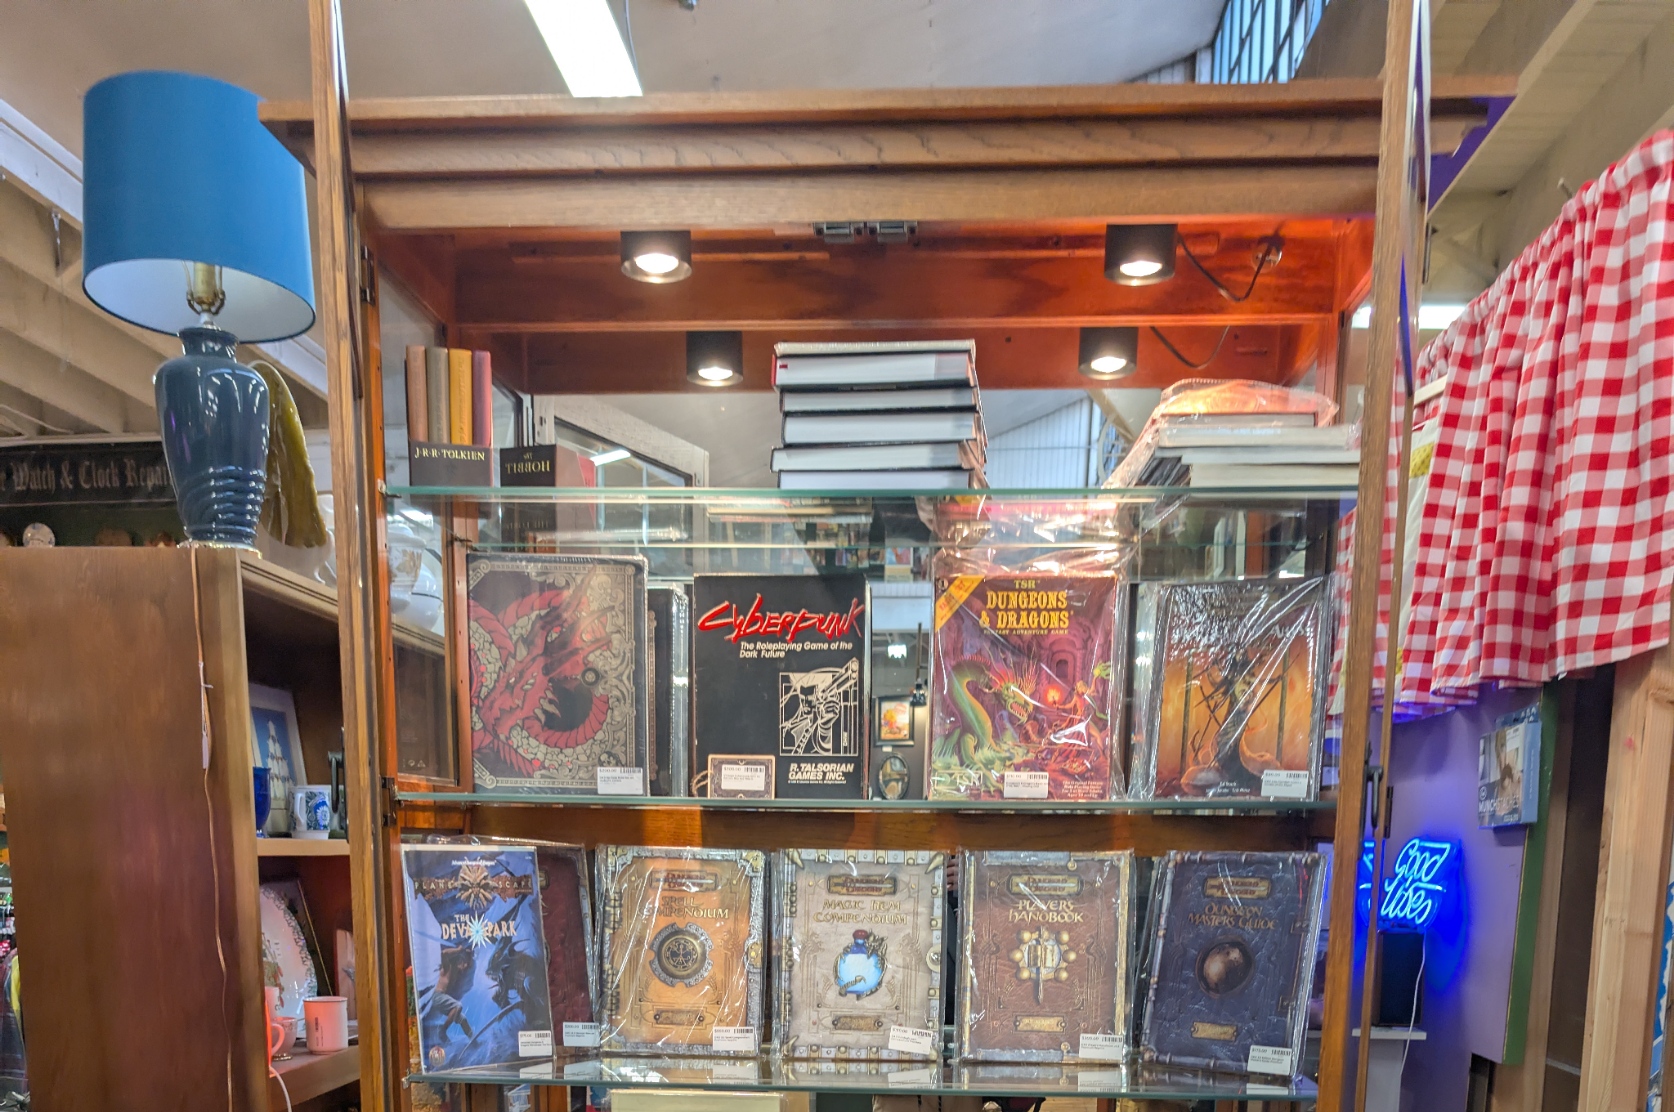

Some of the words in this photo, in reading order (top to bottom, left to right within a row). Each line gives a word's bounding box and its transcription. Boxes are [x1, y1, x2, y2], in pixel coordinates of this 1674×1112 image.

[441, 449, 485, 460] TOLKIEN
[10, 461, 56, 494] Watch
[60, 460, 73, 489] &
[79, 460, 120, 489] Clock
[1014, 580, 1036, 589] TSR
[986, 591, 1067, 609] DUNGEONS
[979, 610, 990, 628] &
[997, 611, 1069, 629] DRAGONS
[740, 641, 755, 650] The
[756, 641, 802, 652] Roleplaying
[804, 642, 828, 650] Game
[830, 642, 838, 650] of
[839, 642, 853, 650] the
[740, 650, 758, 658] Dark
[761, 650, 786, 658] Future
[789, 771, 824, 780] GAMES
[825, 772, 845, 780] INC.
[1394, 838, 1451, 885] Good
[822, 899, 867, 911] MAGIC
[870, 899, 901, 912] ITEM
[1205, 902, 1263, 916] DUNGEON
[454, 914, 470, 922] THE
[813, 911, 908, 925] COMPENDIUM
[1238, 918, 1277, 930] GUIDE
